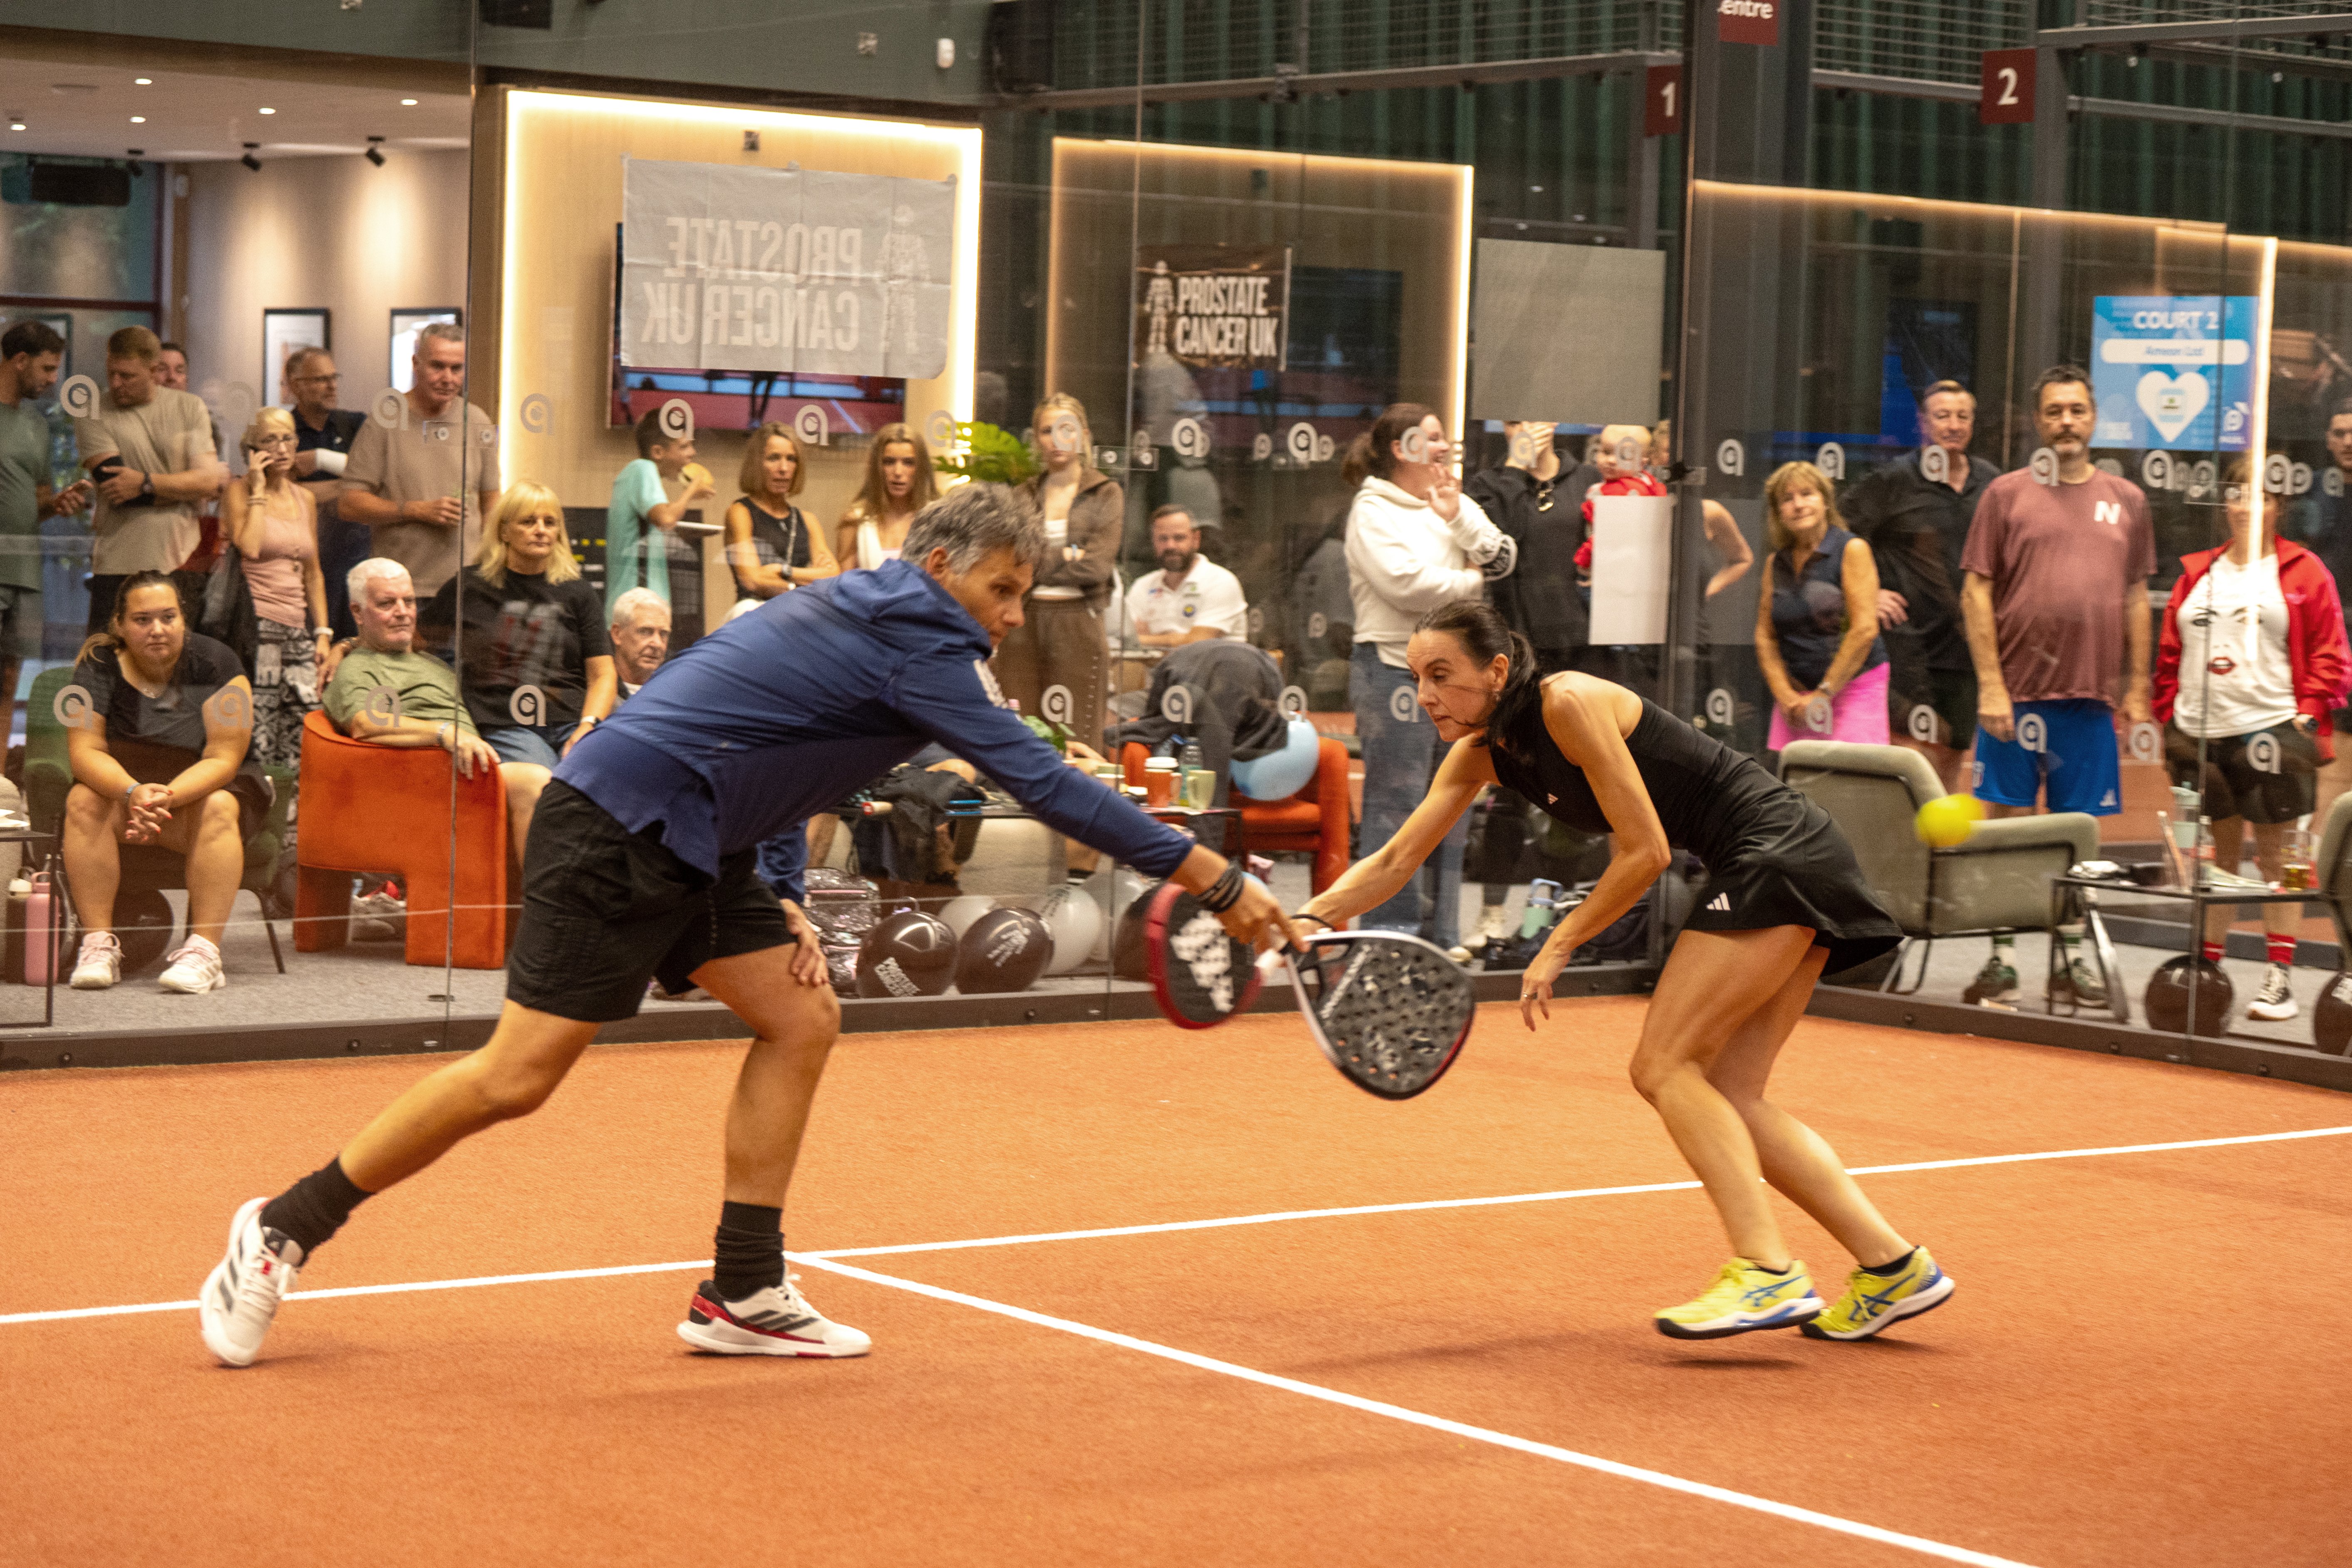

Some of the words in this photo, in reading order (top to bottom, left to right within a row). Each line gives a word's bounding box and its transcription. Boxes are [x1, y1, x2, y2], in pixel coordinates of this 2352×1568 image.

[1717, 0, 1773, 19] entre
[1661, 82, 1676, 117] 1
[1997, 67, 2018, 105] 2
[1177, 276, 1270, 315] PROSTATE
[1176, 316, 1248, 355] CANCER
[1249, 317, 1278, 357] UK
[2133, 311, 2203, 329] COURT
[2207, 311, 2219, 330] 2
[2094, 501, 2121, 524] N
